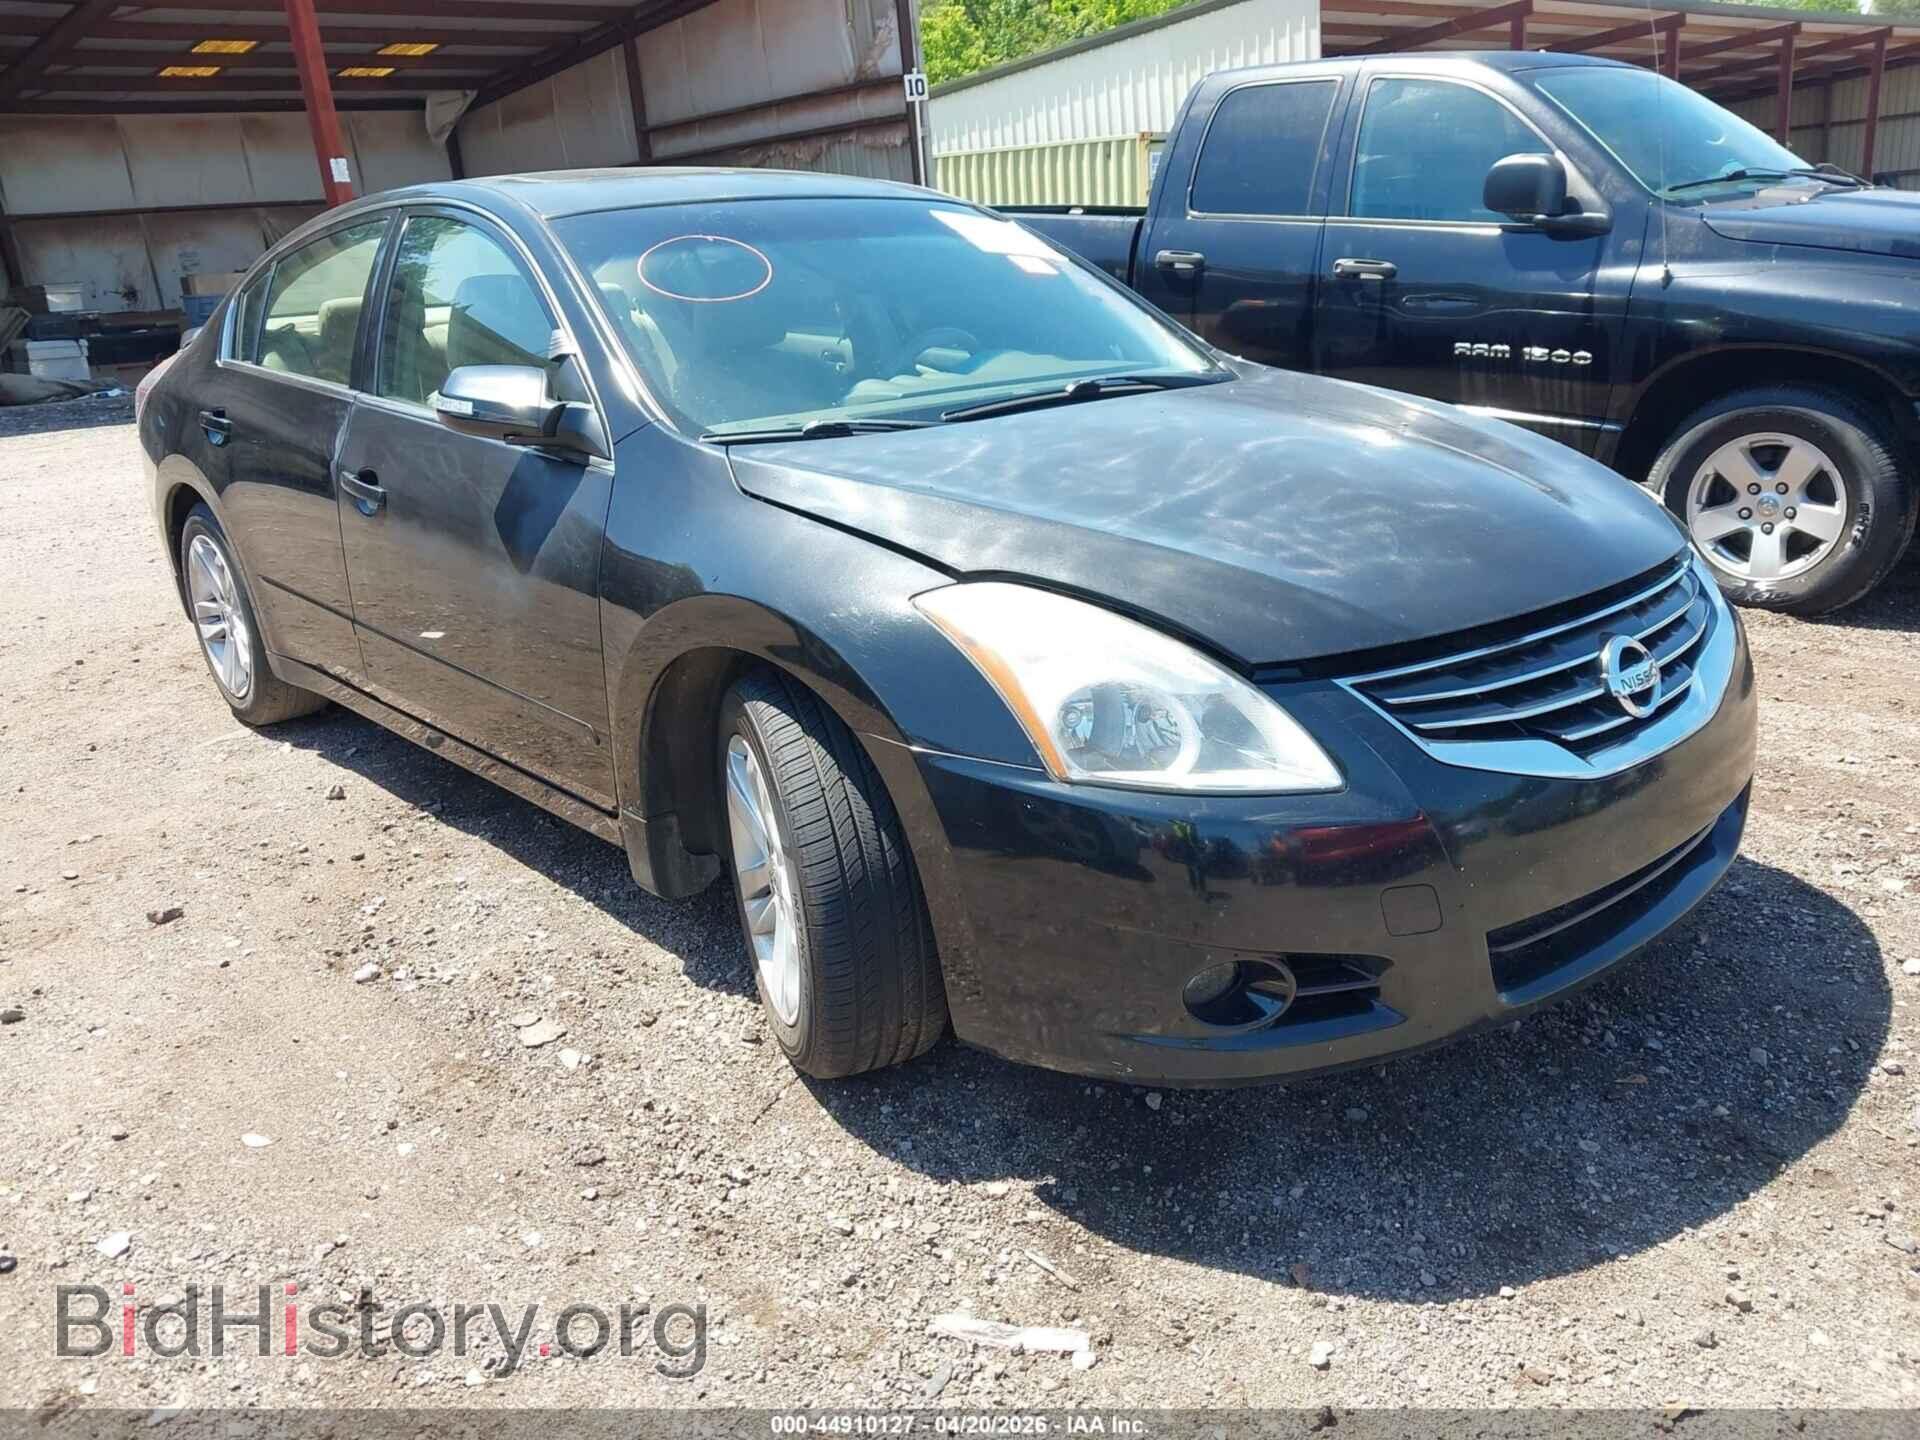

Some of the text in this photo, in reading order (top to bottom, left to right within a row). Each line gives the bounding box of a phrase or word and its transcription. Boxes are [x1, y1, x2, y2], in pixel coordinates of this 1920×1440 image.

[908, 78, 925, 96] 10
[1454, 342, 1593, 365] RAM 1500
